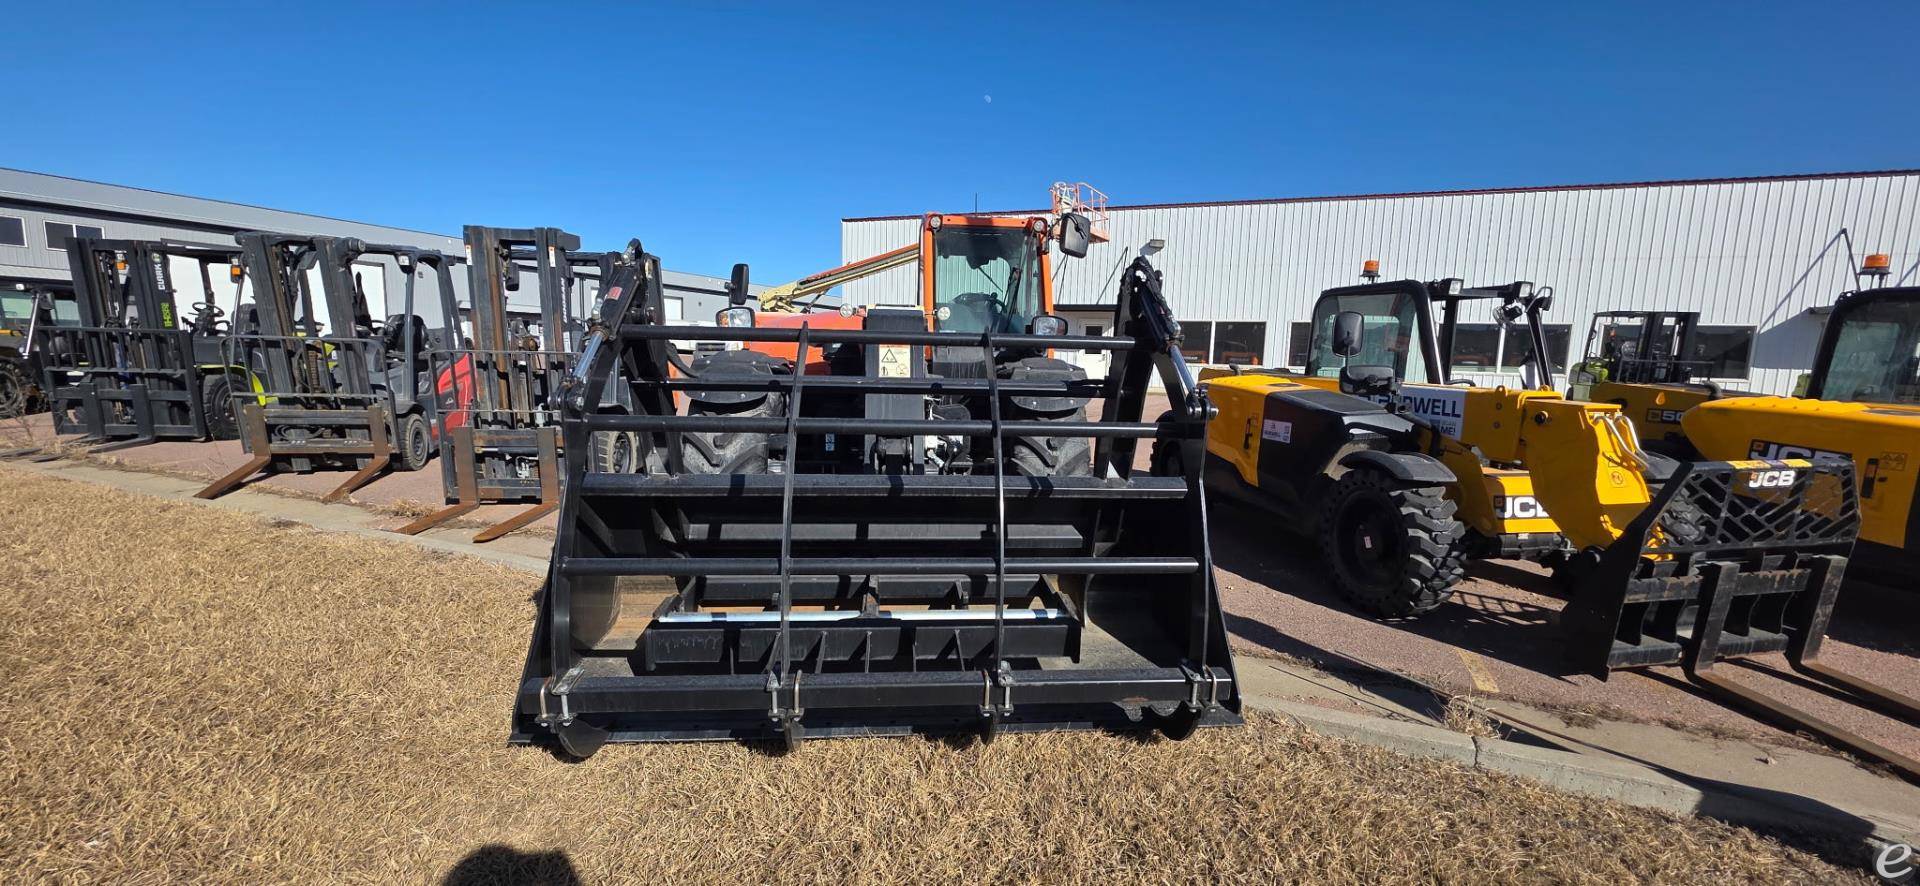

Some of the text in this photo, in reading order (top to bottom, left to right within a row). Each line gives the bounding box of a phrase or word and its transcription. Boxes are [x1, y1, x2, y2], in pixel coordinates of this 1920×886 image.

[154, 263, 165, 290] CLARK
[1378, 394, 1461, 418] BWELL
[1748, 470, 1796, 488] JCB
